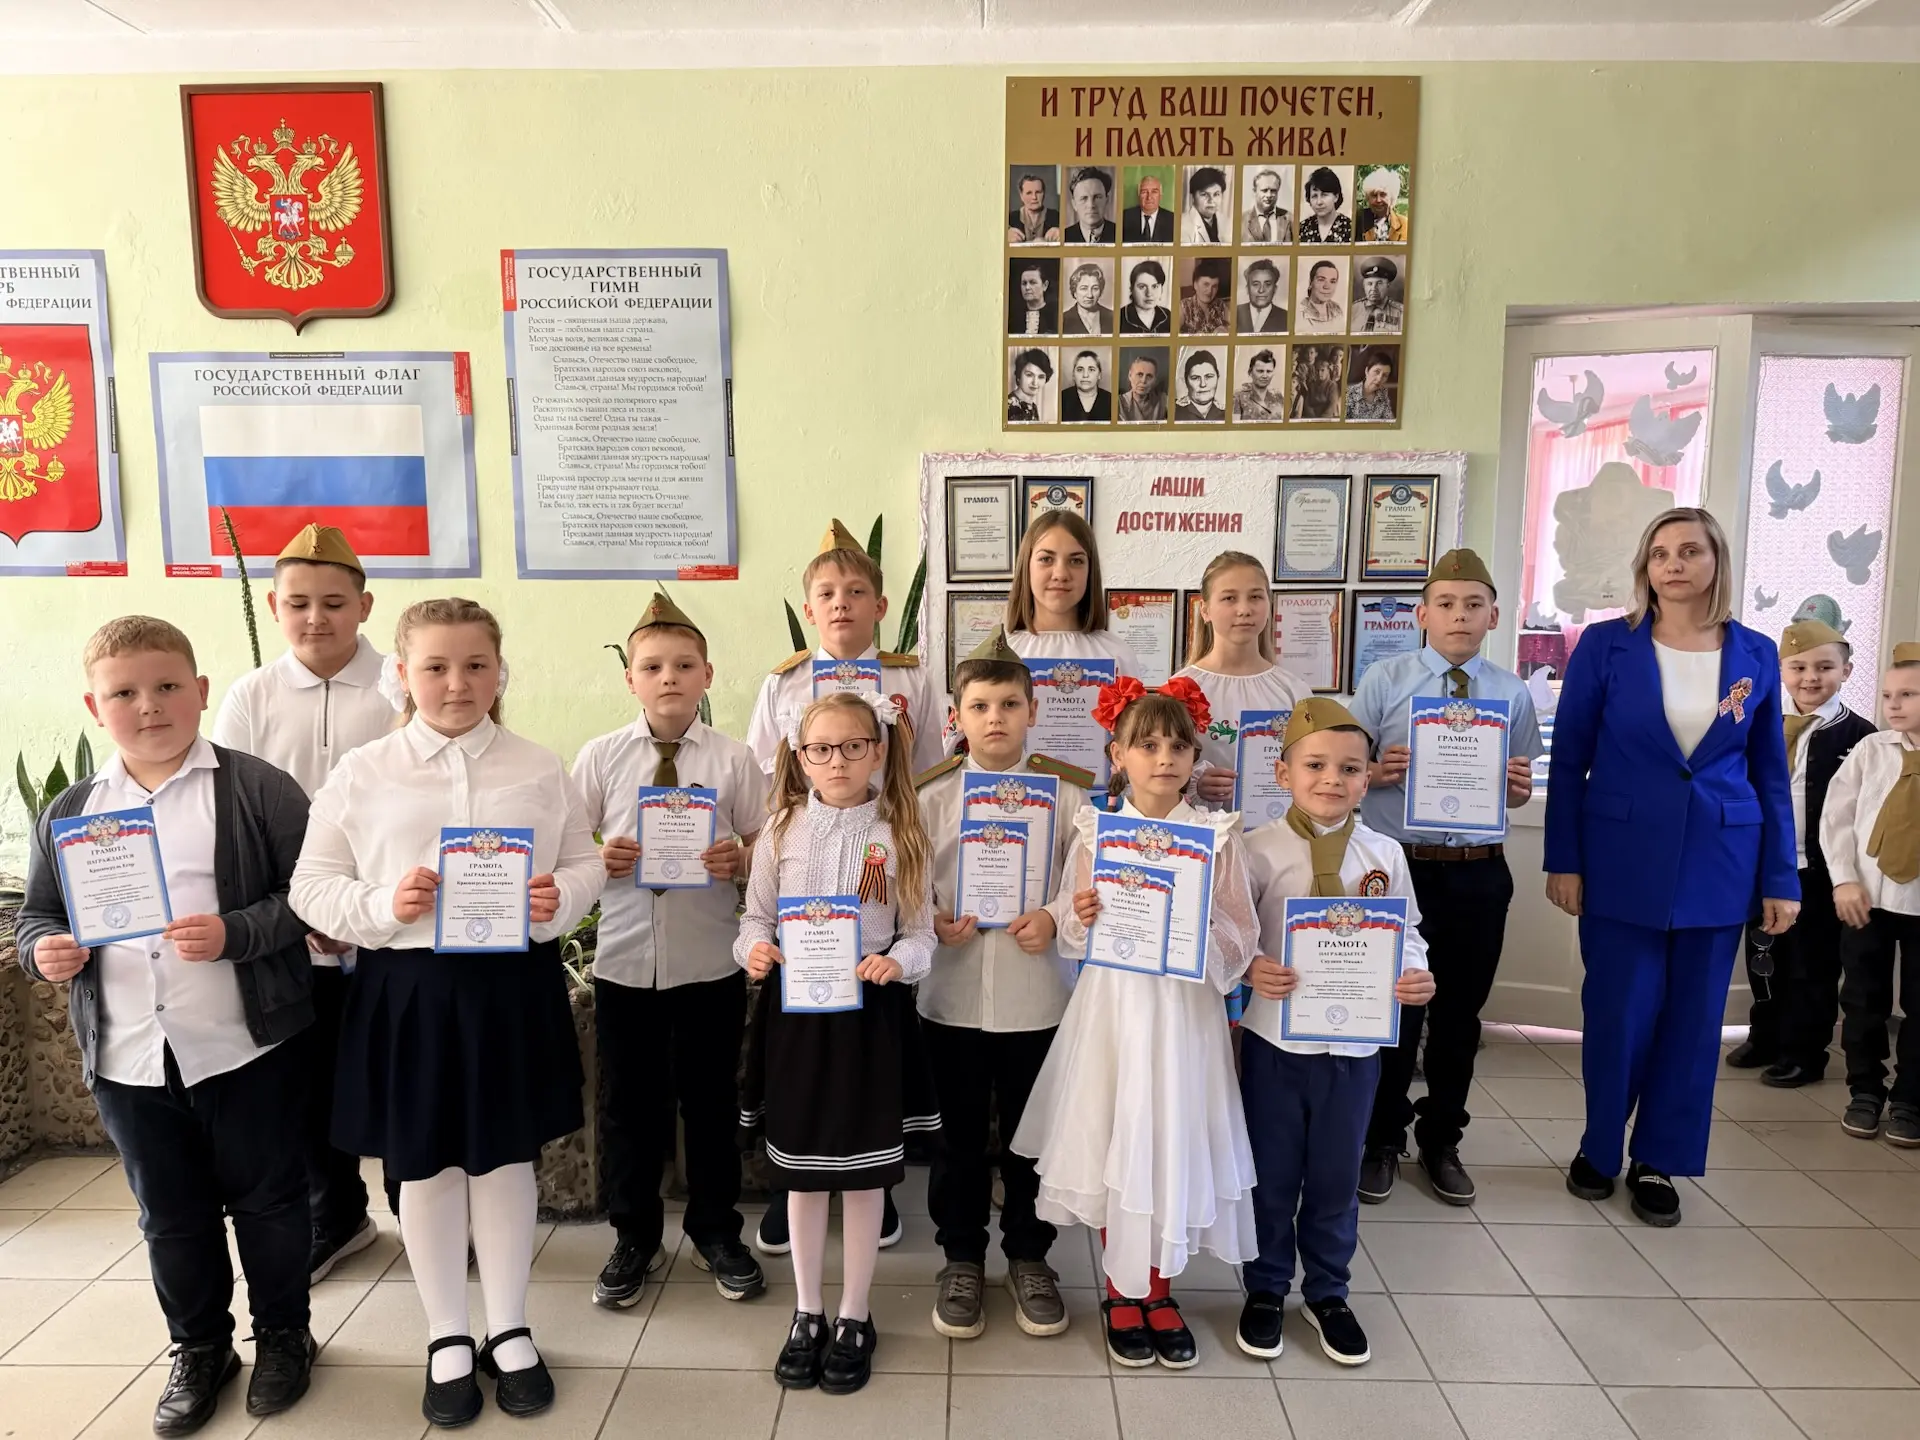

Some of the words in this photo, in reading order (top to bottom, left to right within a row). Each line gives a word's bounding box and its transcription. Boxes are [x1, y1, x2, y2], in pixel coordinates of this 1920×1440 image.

[1042, 87, 1057, 117] И
[1071, 86, 1148, 121] ТРУД
[1160, 86, 1228, 117] ВАШ
[1240, 86, 1383, 120] ПОЧЕТЕН,
[1076, 128, 1092, 157] И
[1106, 126, 1234, 157] ПАМЯТЬ
[1248, 126, 1348, 157] ЖИВА!
[528, 263, 702, 281] ГОСУДАРСТВЕННЫЙ
[590, 281, 639, 293] ГИМН
[6, 298, 92, 310] ФЕДЕРАЦИИ
[520, 296, 618, 310] РОССИЙСКОЙ
[624, 298, 713, 311] ФЕДЕРАЦИИ
[194, 366, 365, 383] ГОСУДАРСТВЕННЫЙ
[375, 368, 421, 381] ФЛАГ
[213, 383, 311, 396] РОССИЙСКОЙ
[317, 384, 403, 397] ФЕДЕРАЦИИ
[1150, 476, 1205, 497] НАШИ
[1116, 511, 1243, 534] ДОСТИЖЕНИЯ
[1281, 599, 1332, 607] ГРАМОТА
[1364, 621, 1415, 631] ГРАМОТА
[91, 845, 127, 856] ГРАМОТА
